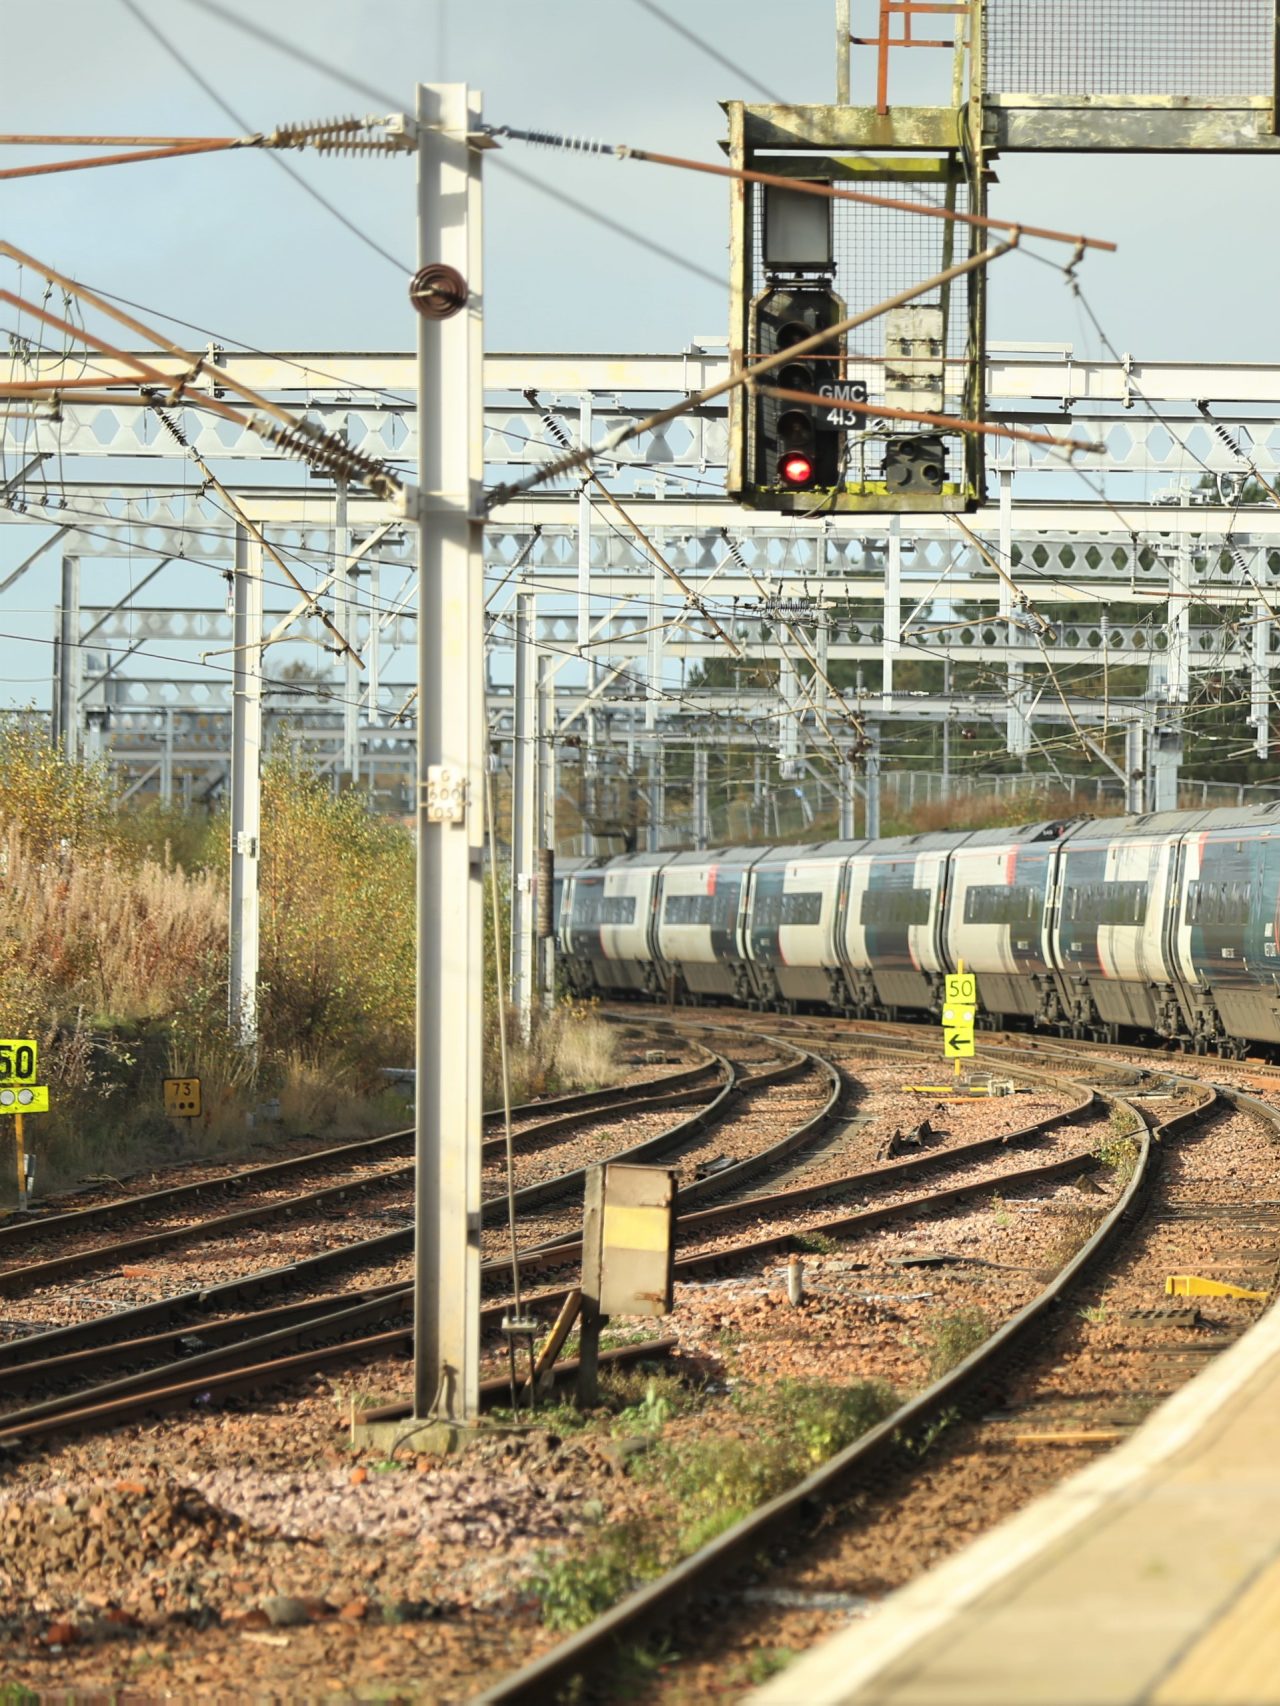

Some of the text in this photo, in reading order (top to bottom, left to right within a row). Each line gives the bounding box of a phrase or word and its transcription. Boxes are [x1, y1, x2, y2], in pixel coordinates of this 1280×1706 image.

[819, 384, 865, 402] GMC
[826, 408, 857, 426] 413
[949, 980, 974, 998] 50
[0, 1045, 34, 1079] 50
[172, 1082, 191, 1097] 73
